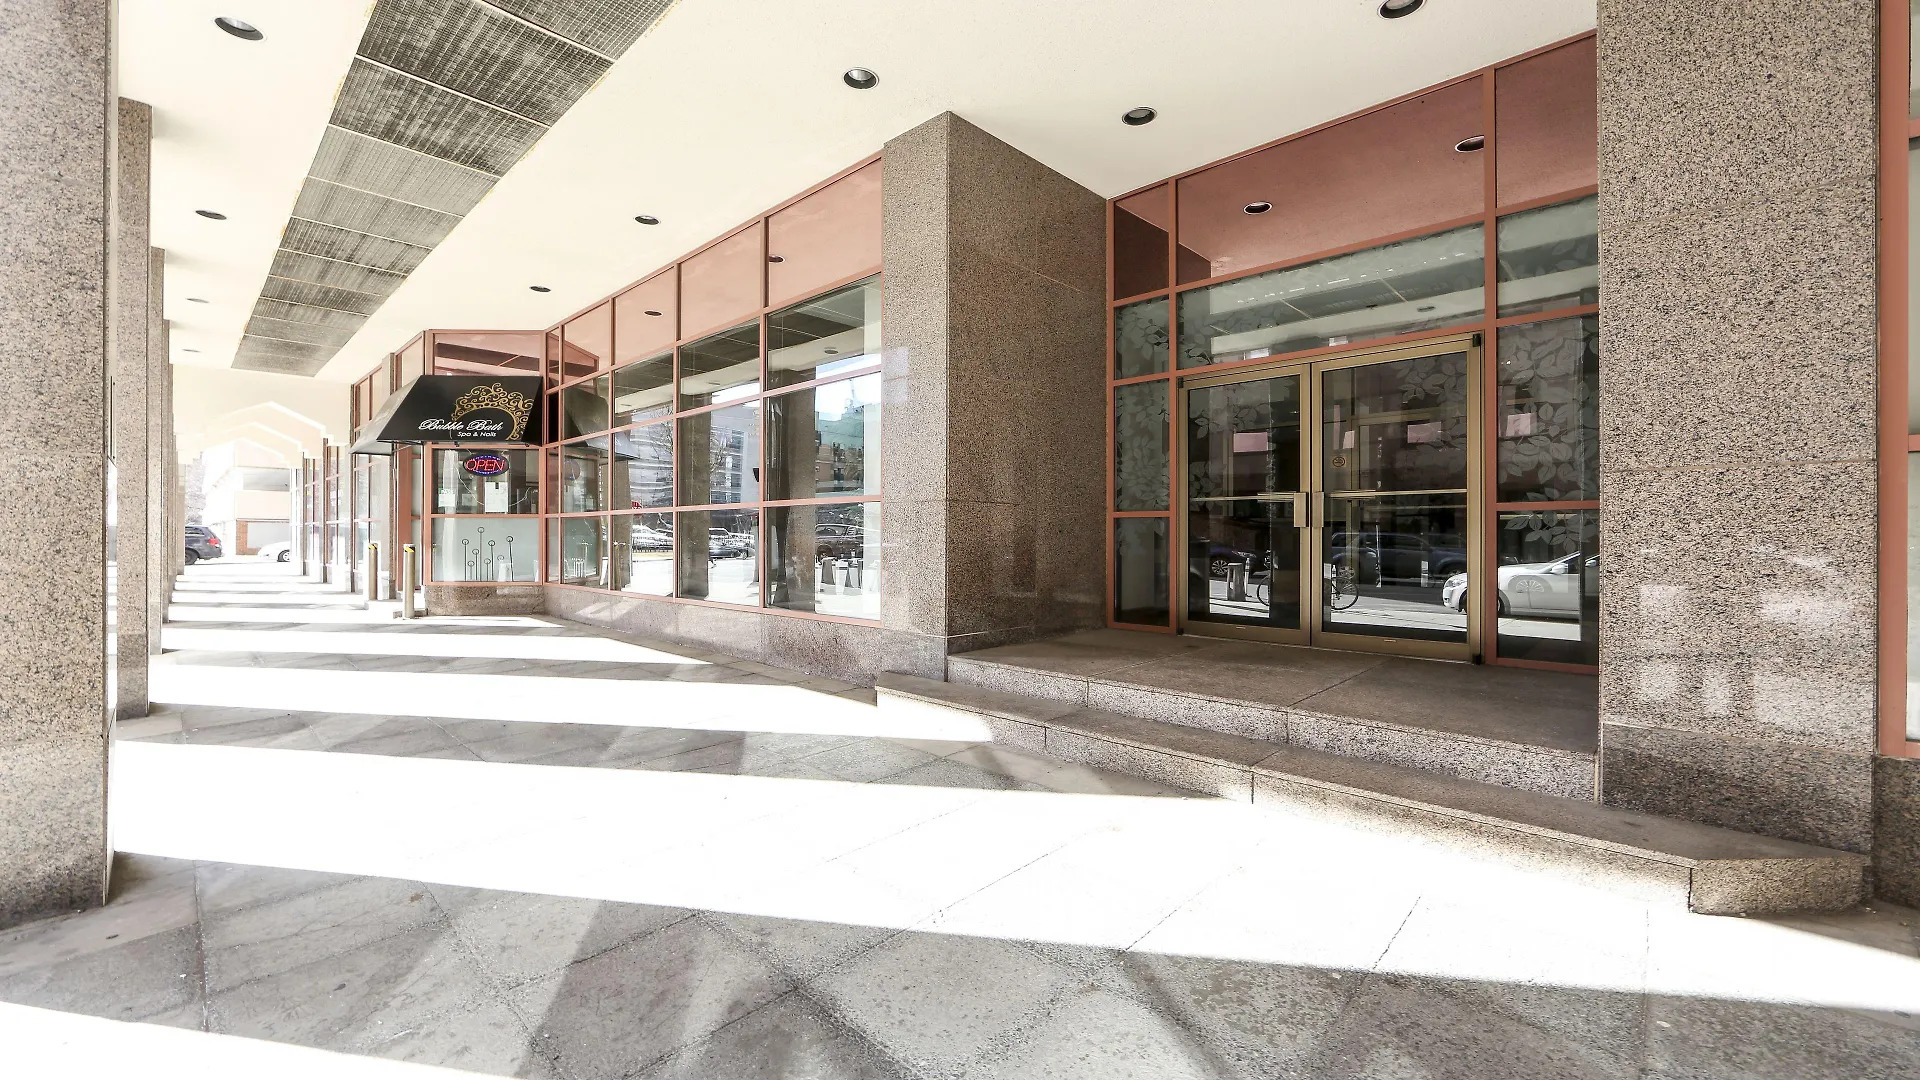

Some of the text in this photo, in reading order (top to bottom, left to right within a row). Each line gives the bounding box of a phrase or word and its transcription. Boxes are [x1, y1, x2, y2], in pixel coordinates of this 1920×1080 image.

[418, 418, 504, 431] Bubble Bath
[465, 459, 505, 471] OPEN
